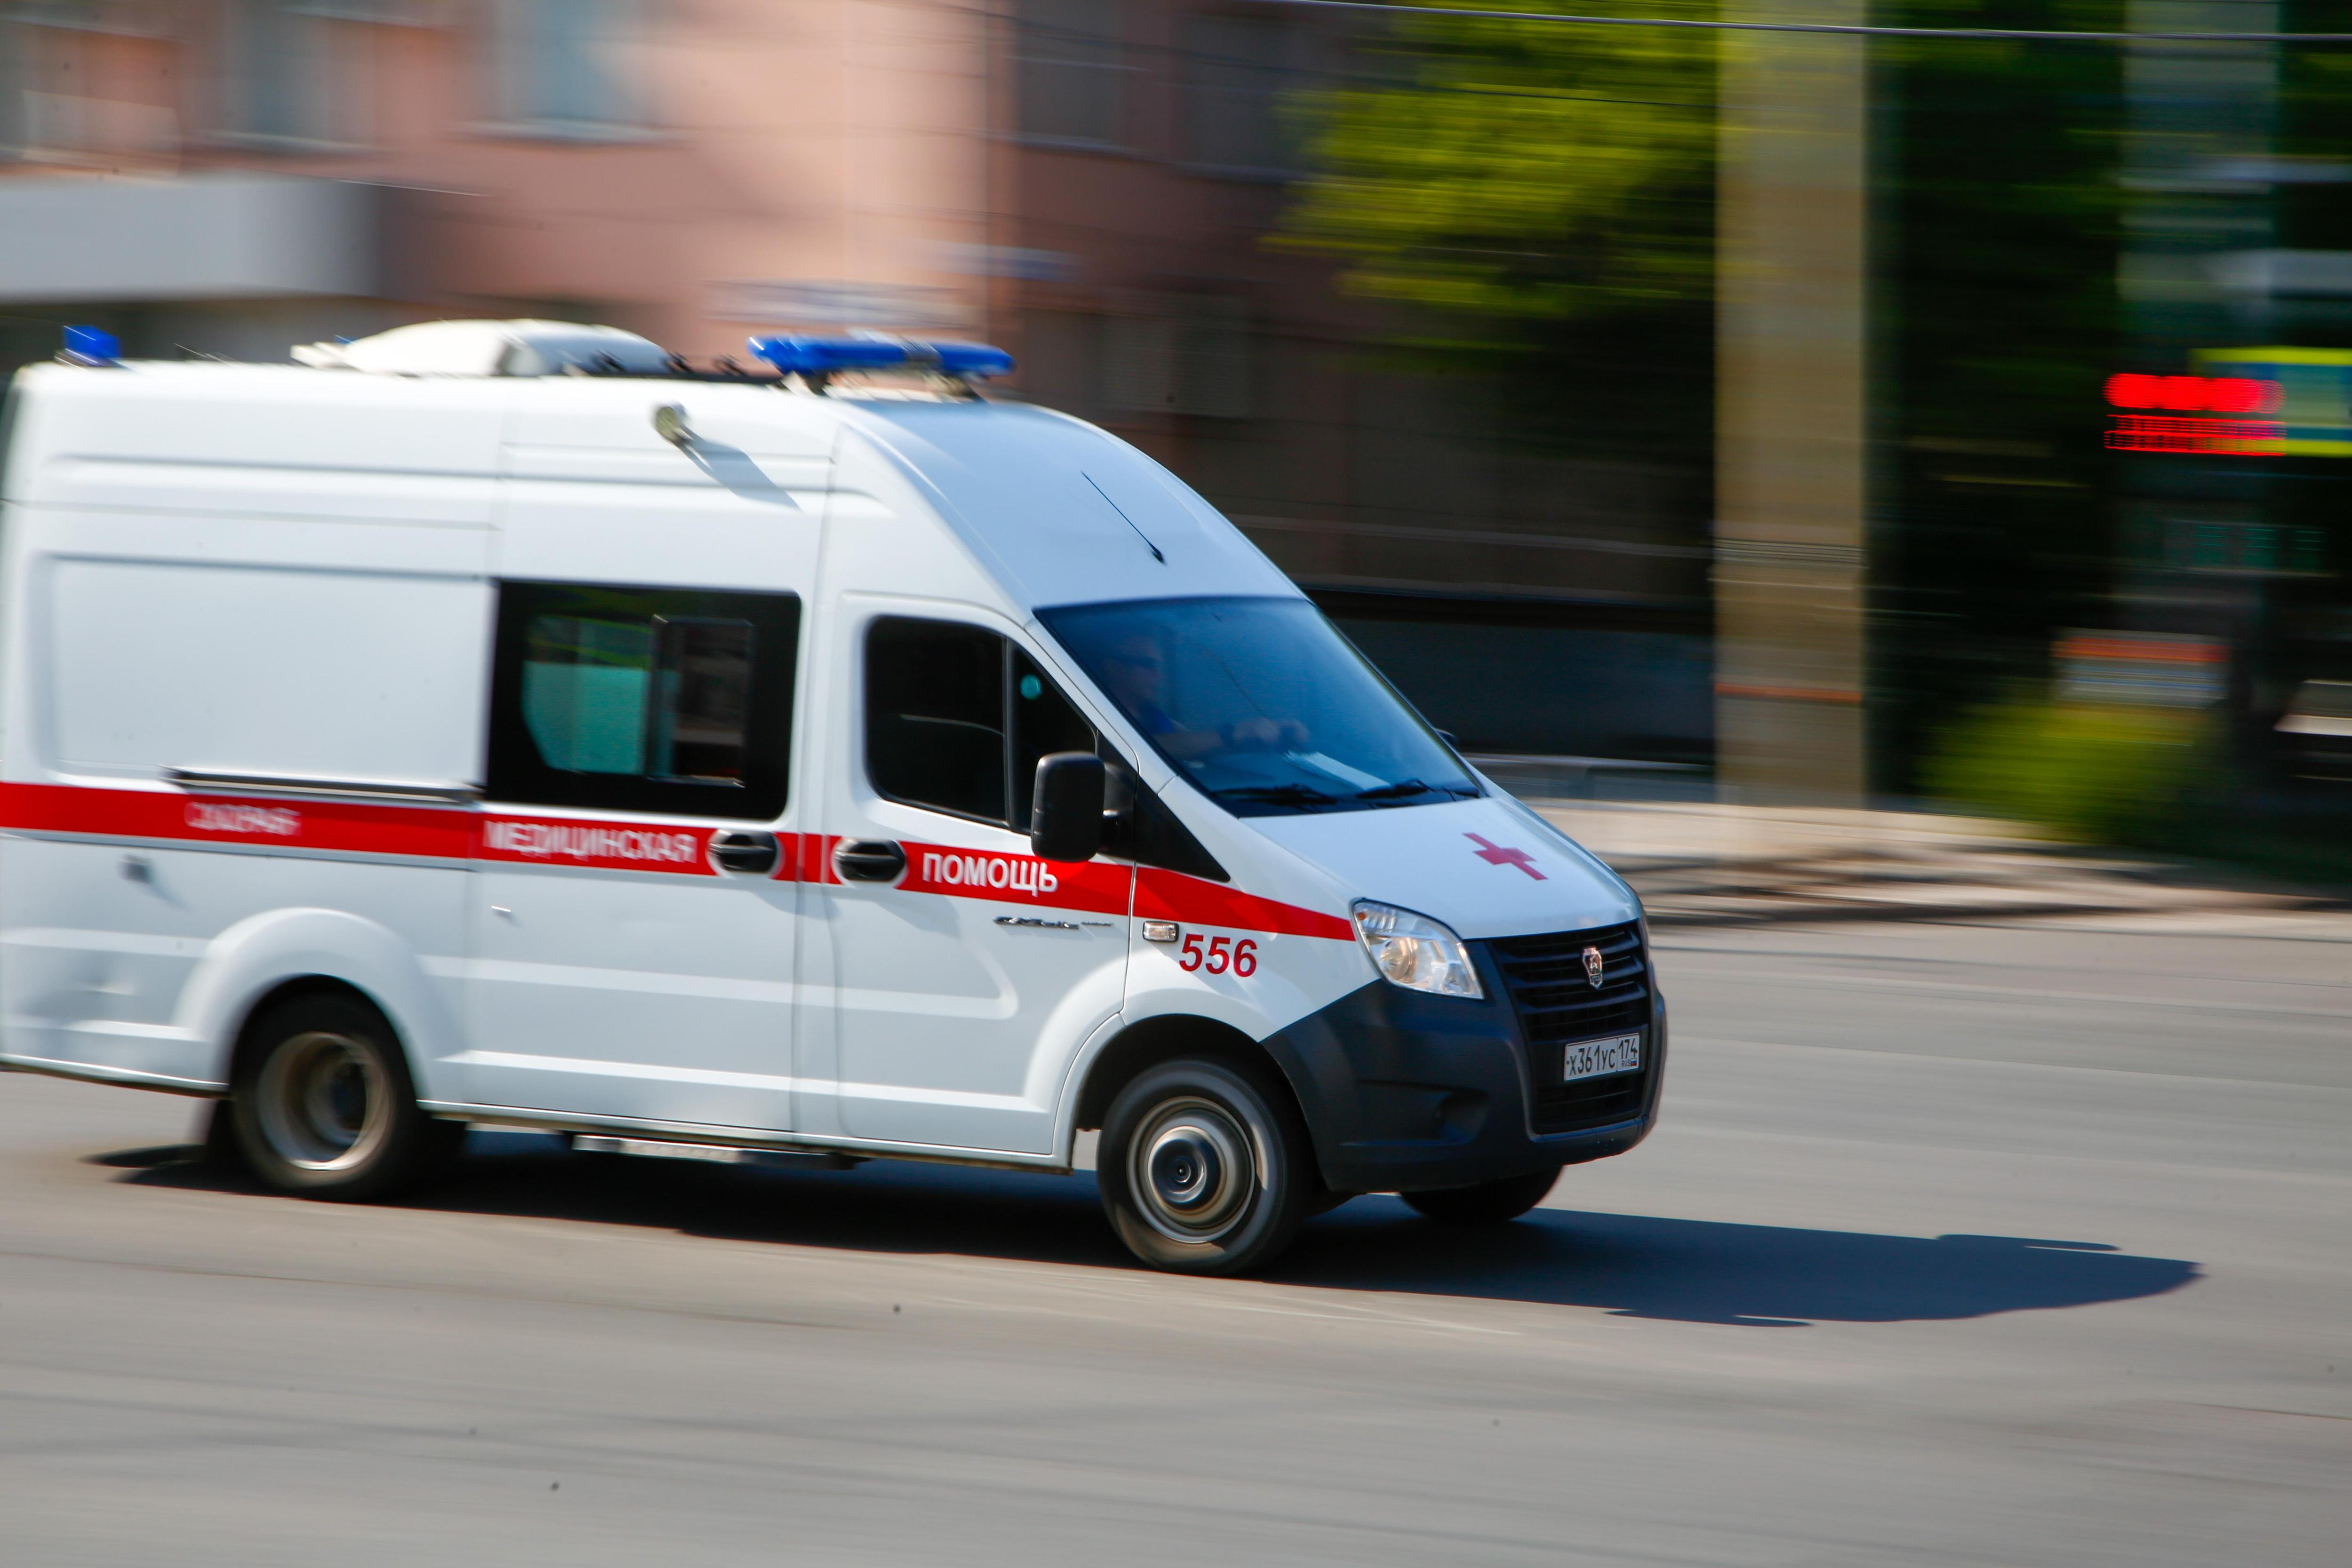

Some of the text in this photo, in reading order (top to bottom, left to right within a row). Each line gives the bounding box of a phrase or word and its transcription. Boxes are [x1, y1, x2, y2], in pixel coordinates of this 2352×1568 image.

[482, 820, 697, 863] МЕДИЦИНСКАЯ
[922, 852, 1058, 897] ПОМОЩЬ
[1179, 933, 1257, 978] 556
[1619, 1038, 1637, 1059] 174
